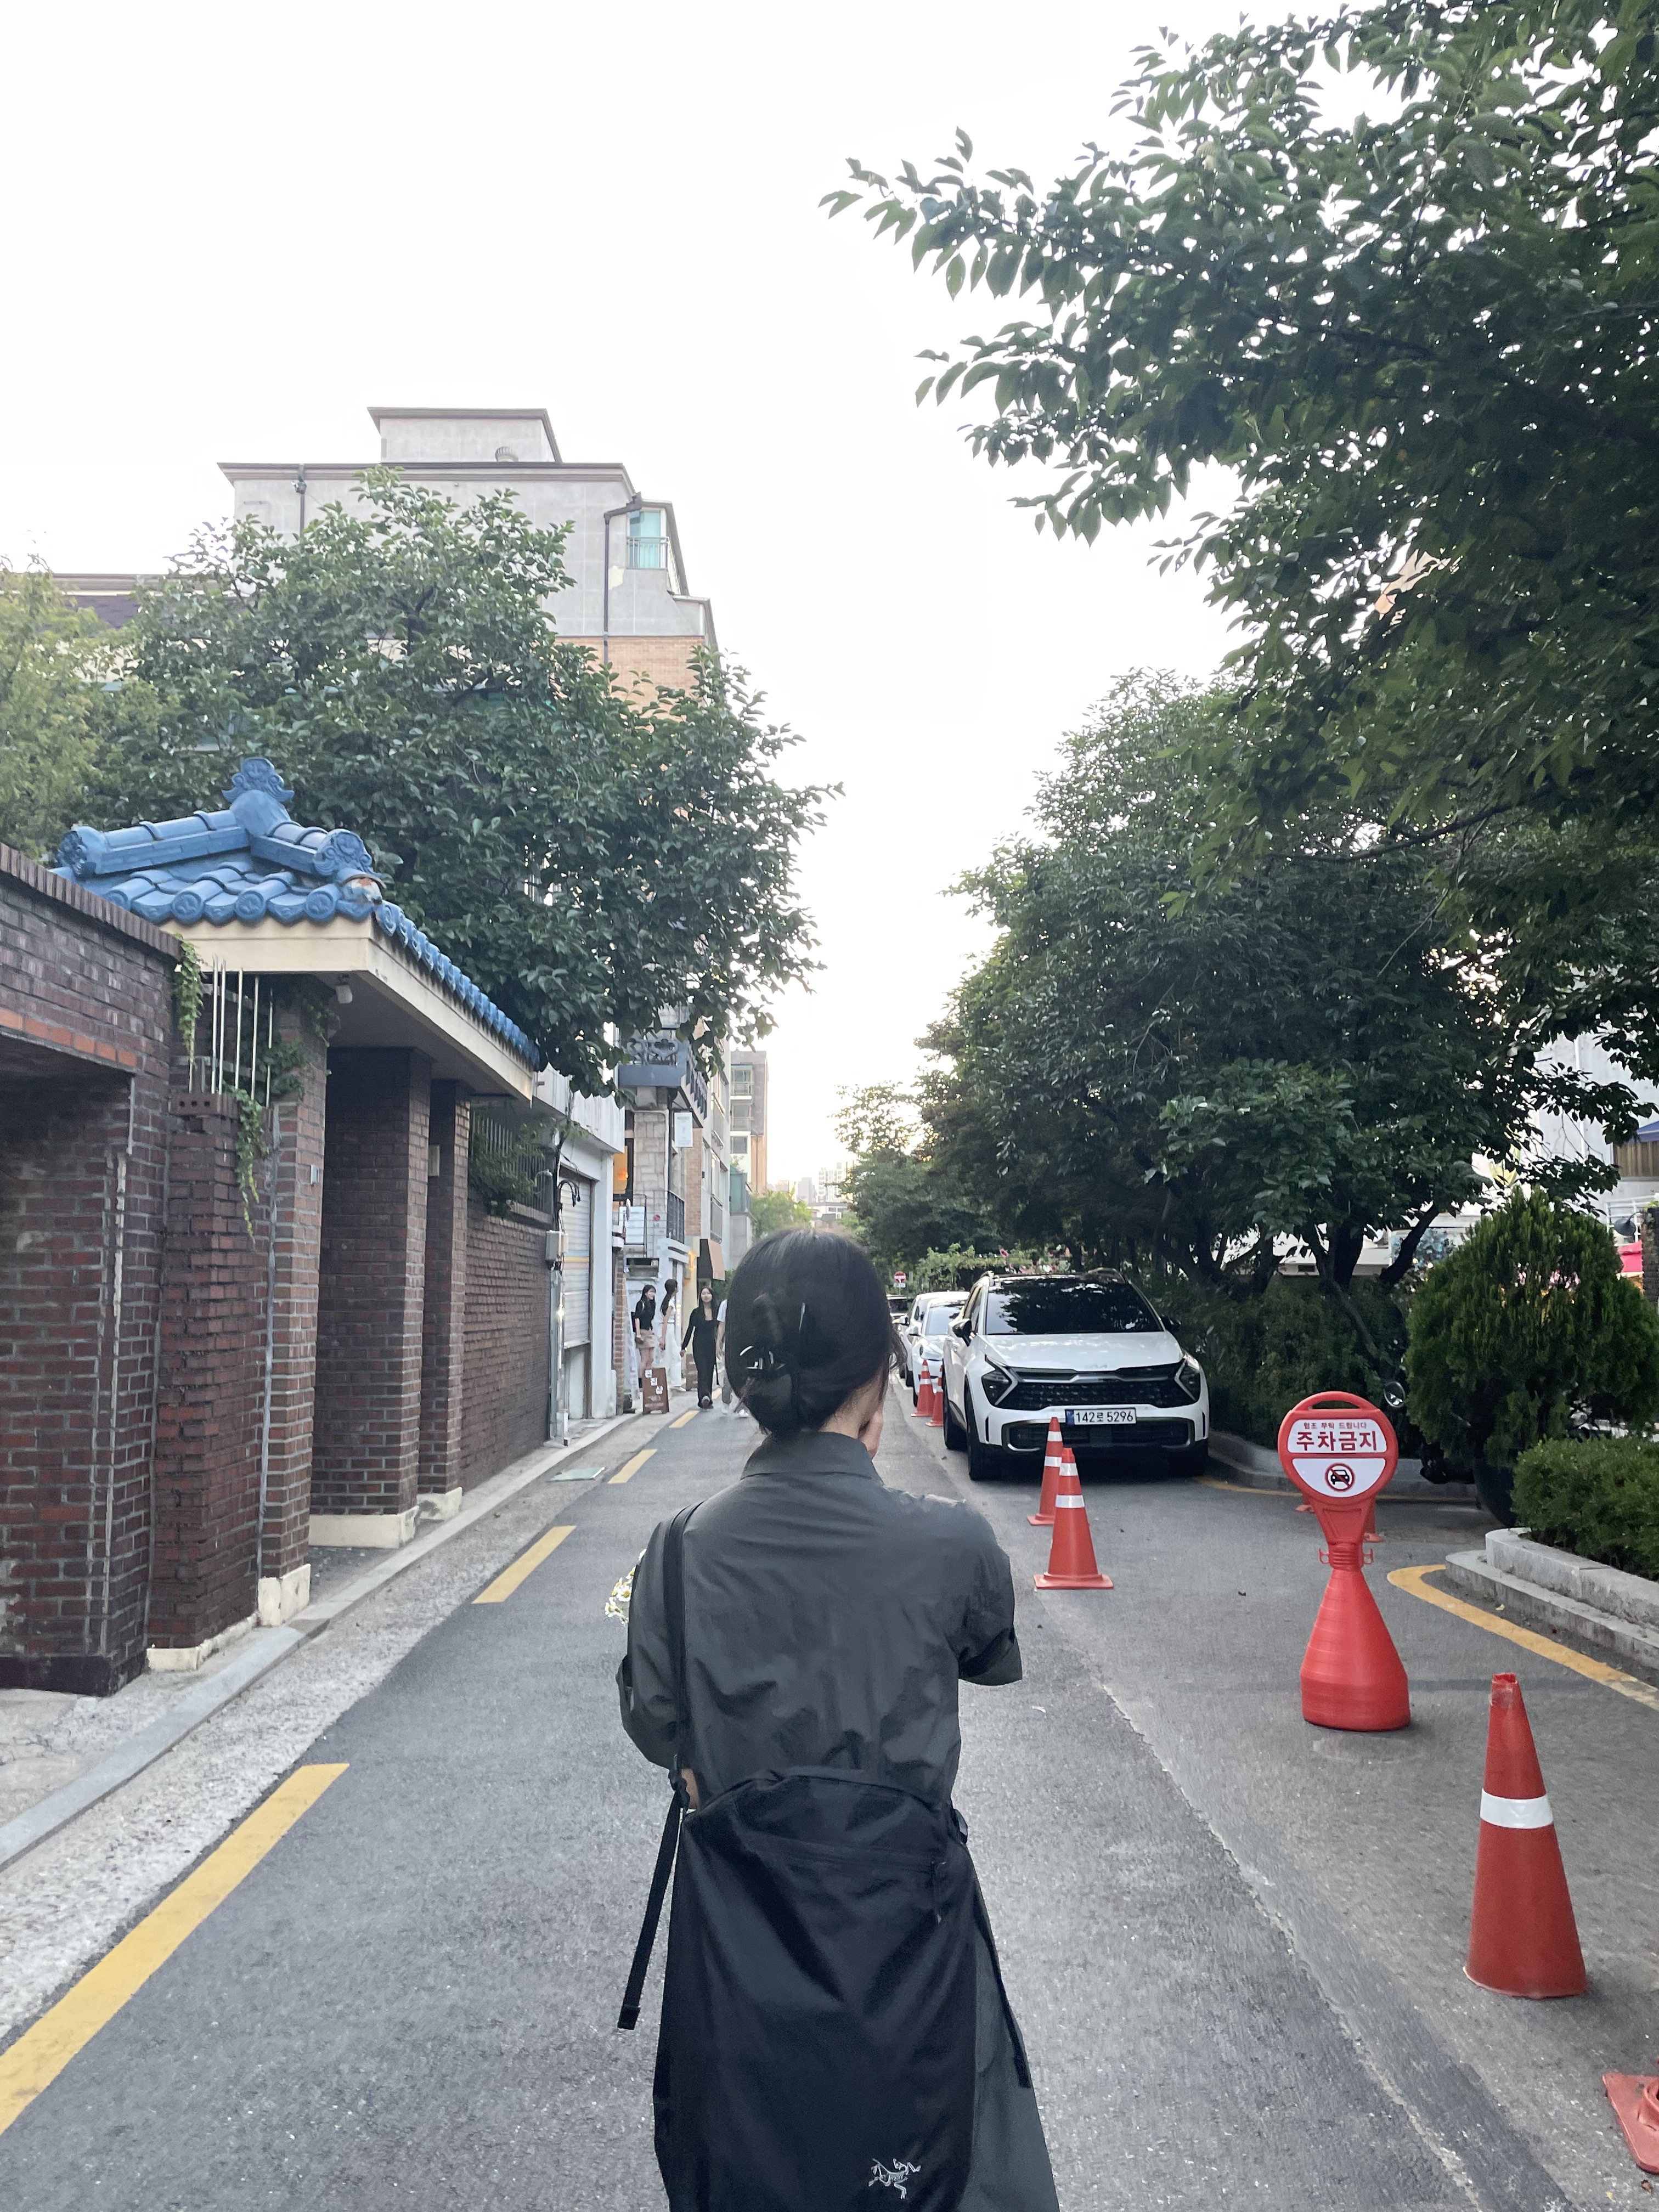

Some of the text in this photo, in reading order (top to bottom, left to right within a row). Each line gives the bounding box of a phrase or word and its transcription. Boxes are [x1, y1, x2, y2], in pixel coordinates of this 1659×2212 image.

[1076, 1411, 1133, 1423] 142로 5296
[1339, 1421, 1367, 1430] 드립니다
[1296, 1431, 1377, 1451] 주차금지
